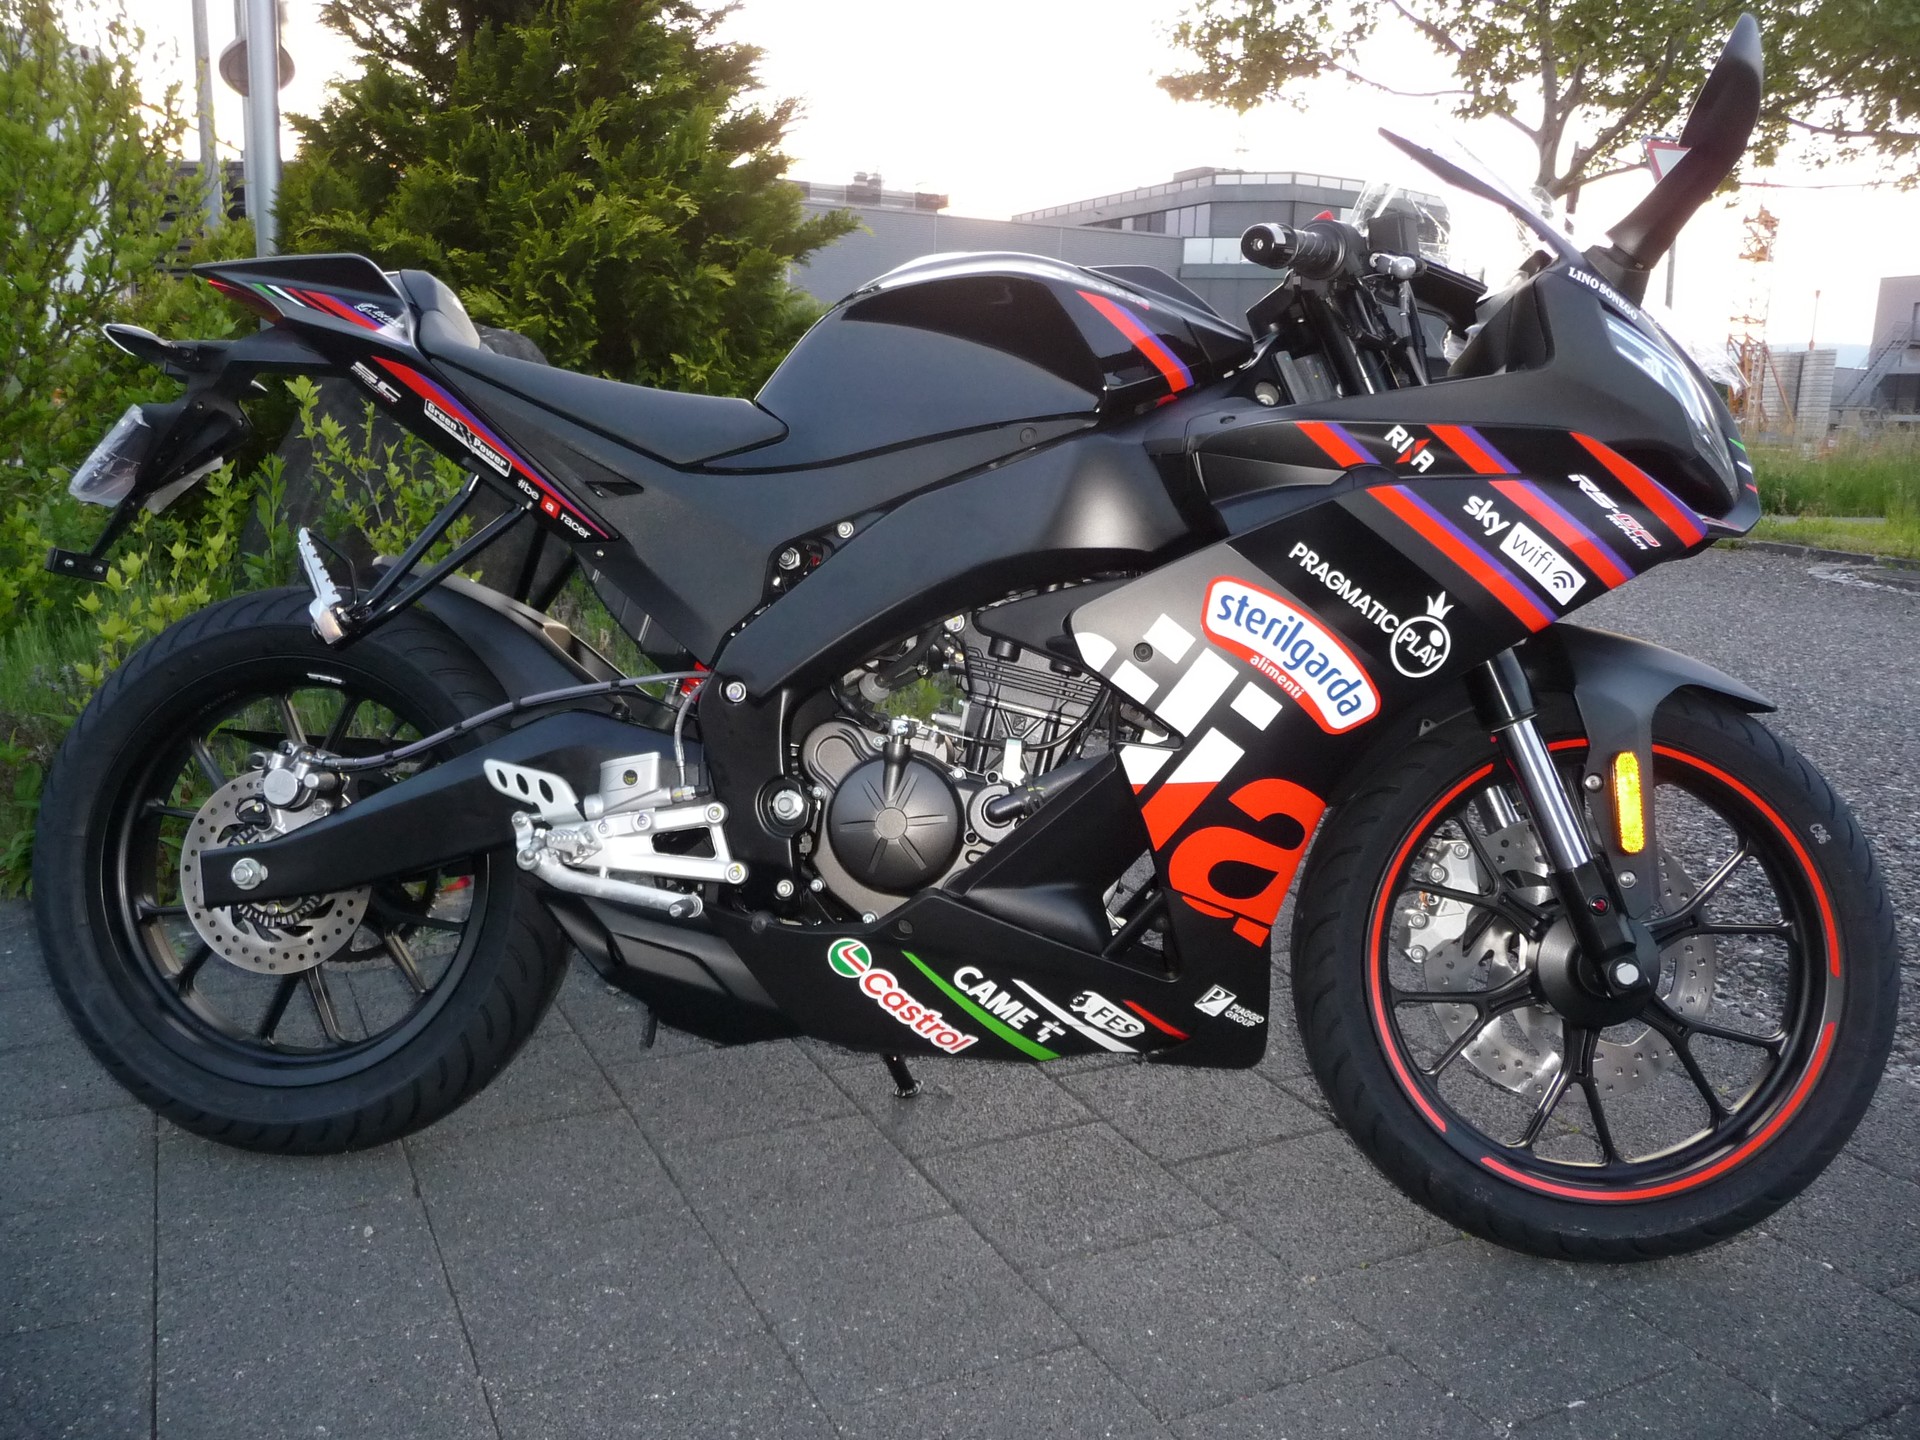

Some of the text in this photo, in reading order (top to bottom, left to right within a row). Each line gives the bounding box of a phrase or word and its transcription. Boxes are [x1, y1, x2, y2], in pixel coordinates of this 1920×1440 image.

[1567, 266, 1638, 321] LINO SONEGO
[427, 402, 457, 431] Green
[473, 437, 508, 467] Power
[517, 479, 540, 500] #be
[560, 513, 592, 538] racer
[1462, 495, 1556, 575] sky wifi
[1605, 514, 1649, 550] REPLICA
[1288, 541, 1400, 634] PRAGMATIC
[1216, 594, 1363, 717] sterilgarda
[1249, 654, 1306, 699] alimenti
[1397, 627, 1443, 668] PLAY
[863, 972, 976, 1053] Castrol
[953, 966, 1039, 1030] CAME
[1224, 1010, 1256, 1027] GROUP
[1230, 1003, 1265, 1024] PIAGGIO
